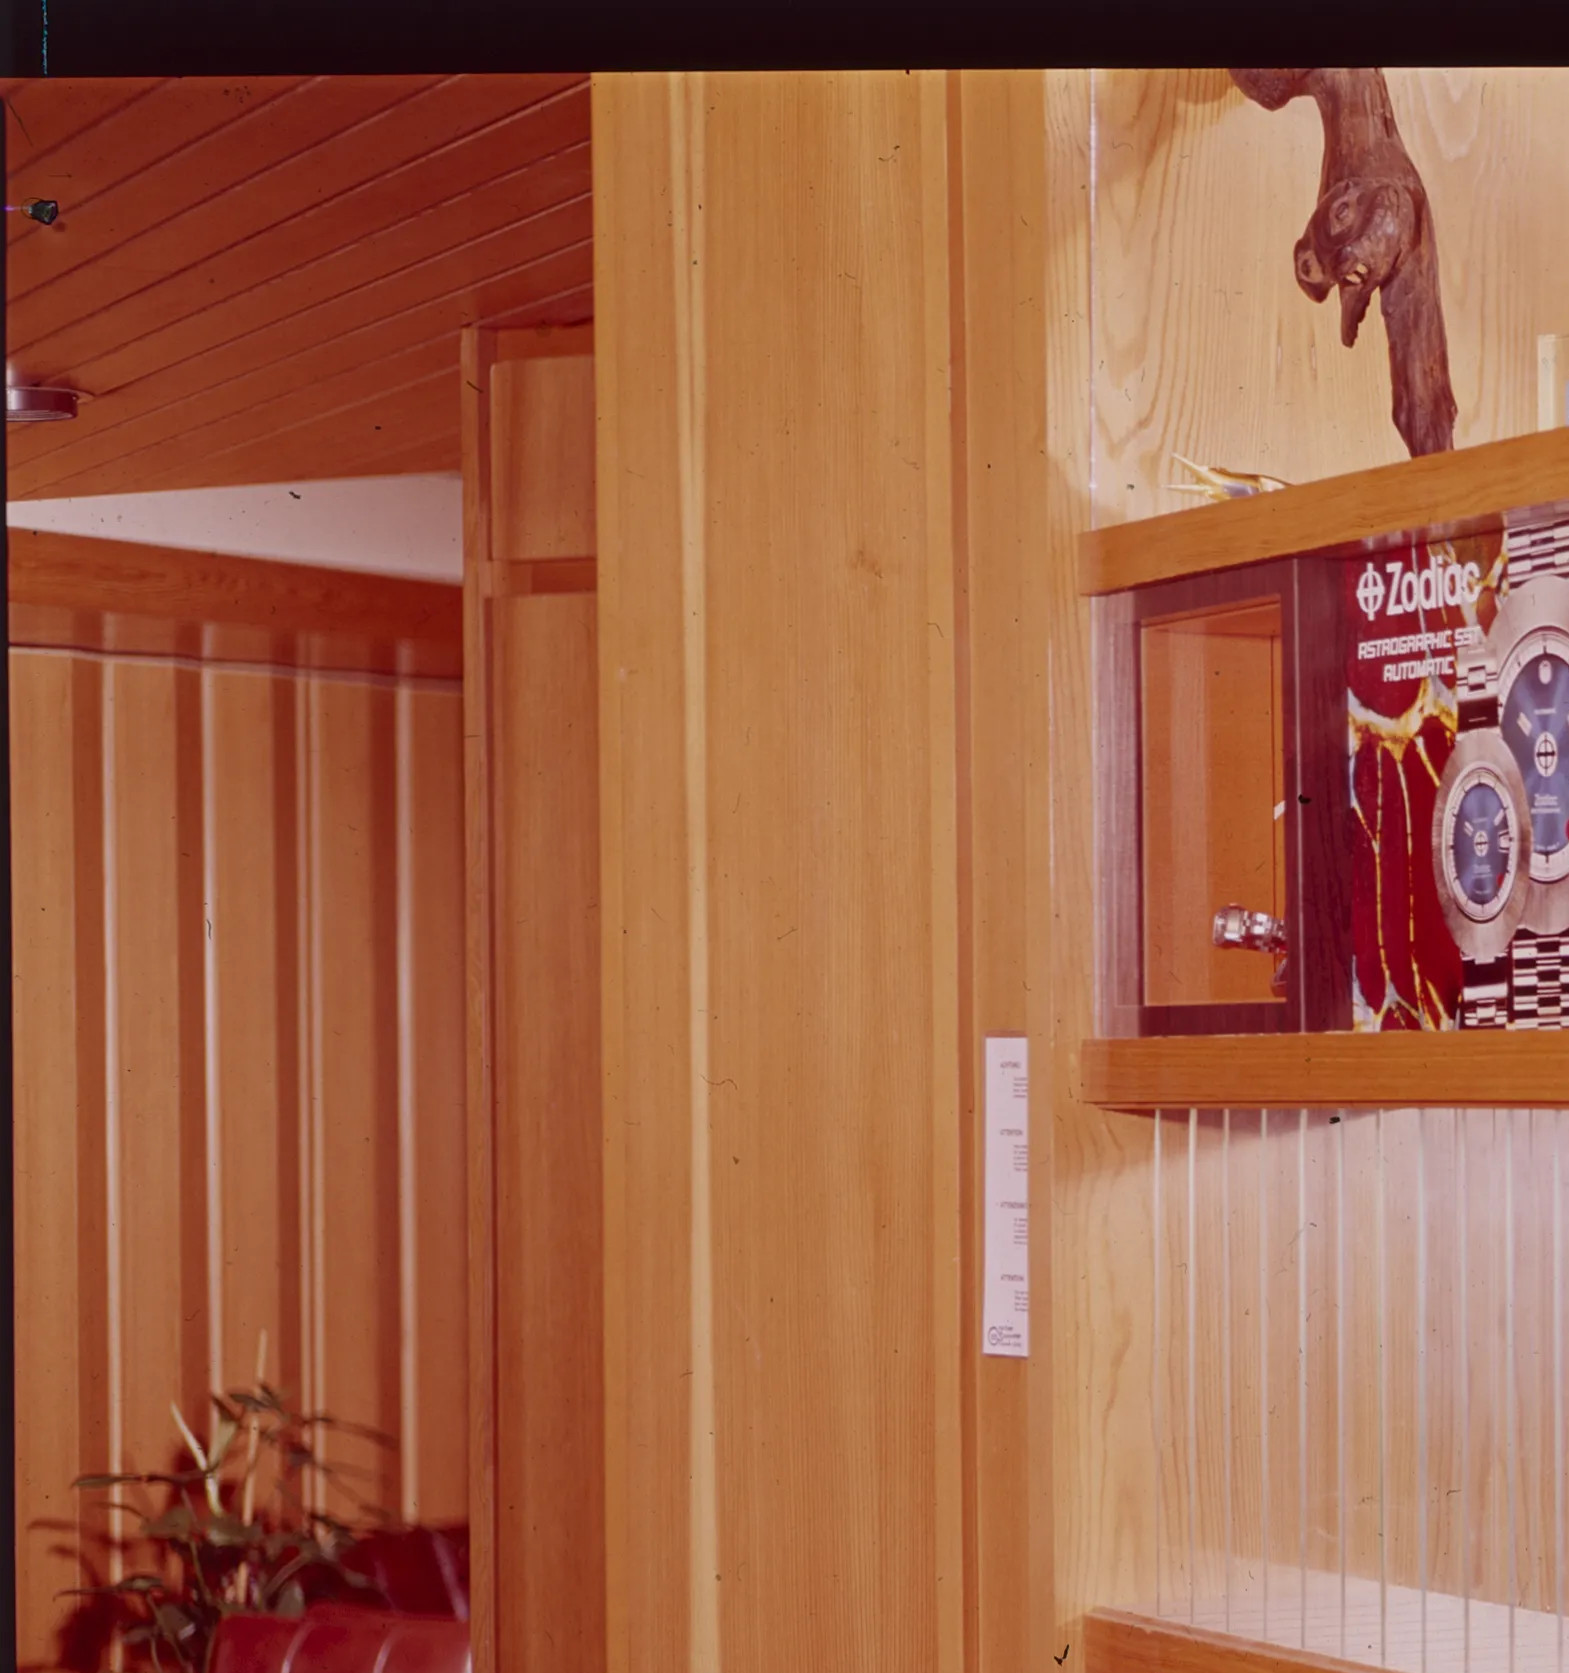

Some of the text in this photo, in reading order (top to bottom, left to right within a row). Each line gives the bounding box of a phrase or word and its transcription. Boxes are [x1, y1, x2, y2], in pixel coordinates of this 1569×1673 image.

[1386, 554, 1481, 616] Zodiac
[1358, 630, 1453, 660] ASTROGRAPHIC
[1383, 656, 1455, 682] AUTOMATIC
